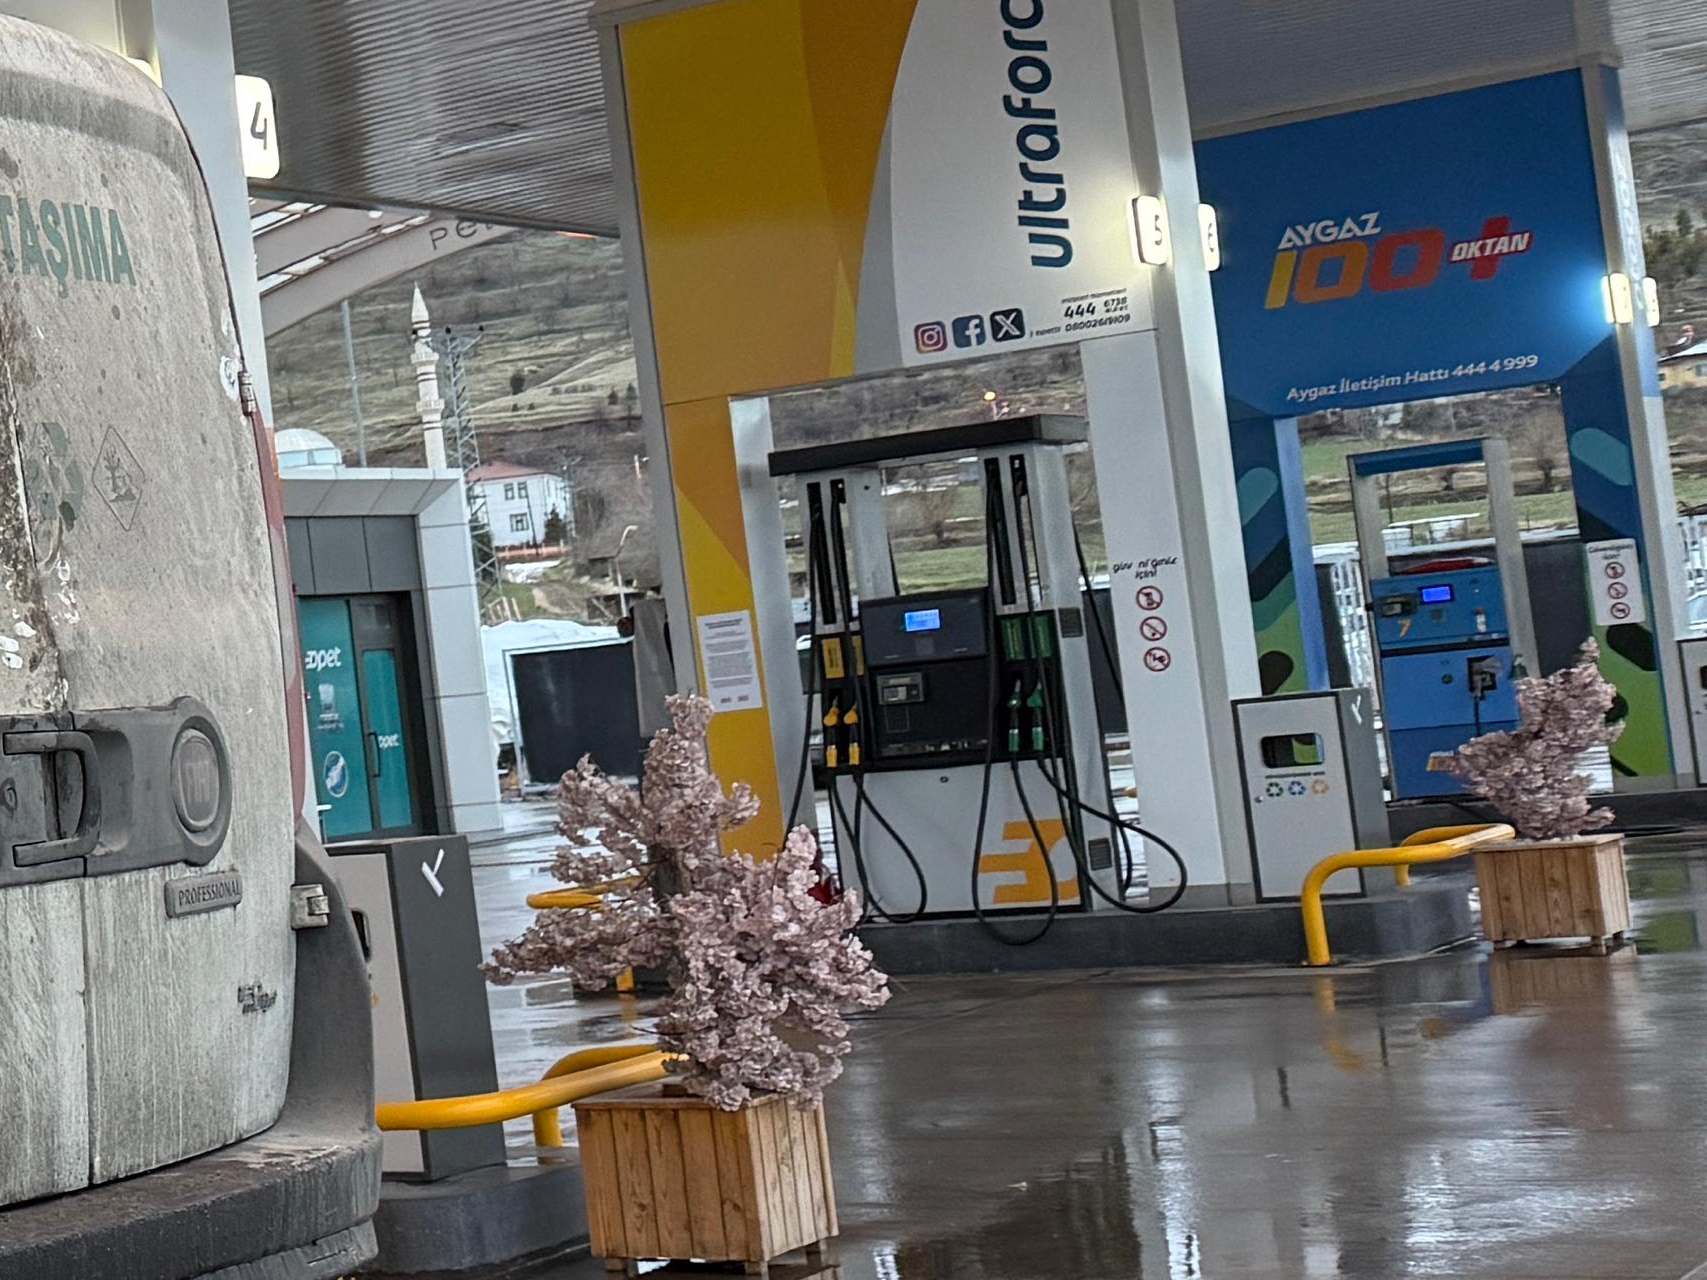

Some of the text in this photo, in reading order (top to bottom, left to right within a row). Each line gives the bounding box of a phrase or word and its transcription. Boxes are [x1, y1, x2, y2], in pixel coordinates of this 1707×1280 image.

[250, 101, 269, 151] 4
[1277, 211, 1382, 251] AYGAZ
[1450, 232, 1530, 262] OKTAN
[1064, 302, 1096, 319] 444
[1287, 383, 1337, 402] Aygaz
[1339, 374, 1402, 395] İletişim
[1403, 368, 1449, 385] Hattı
[178, 878, 241, 907] PROFESSIONAL
